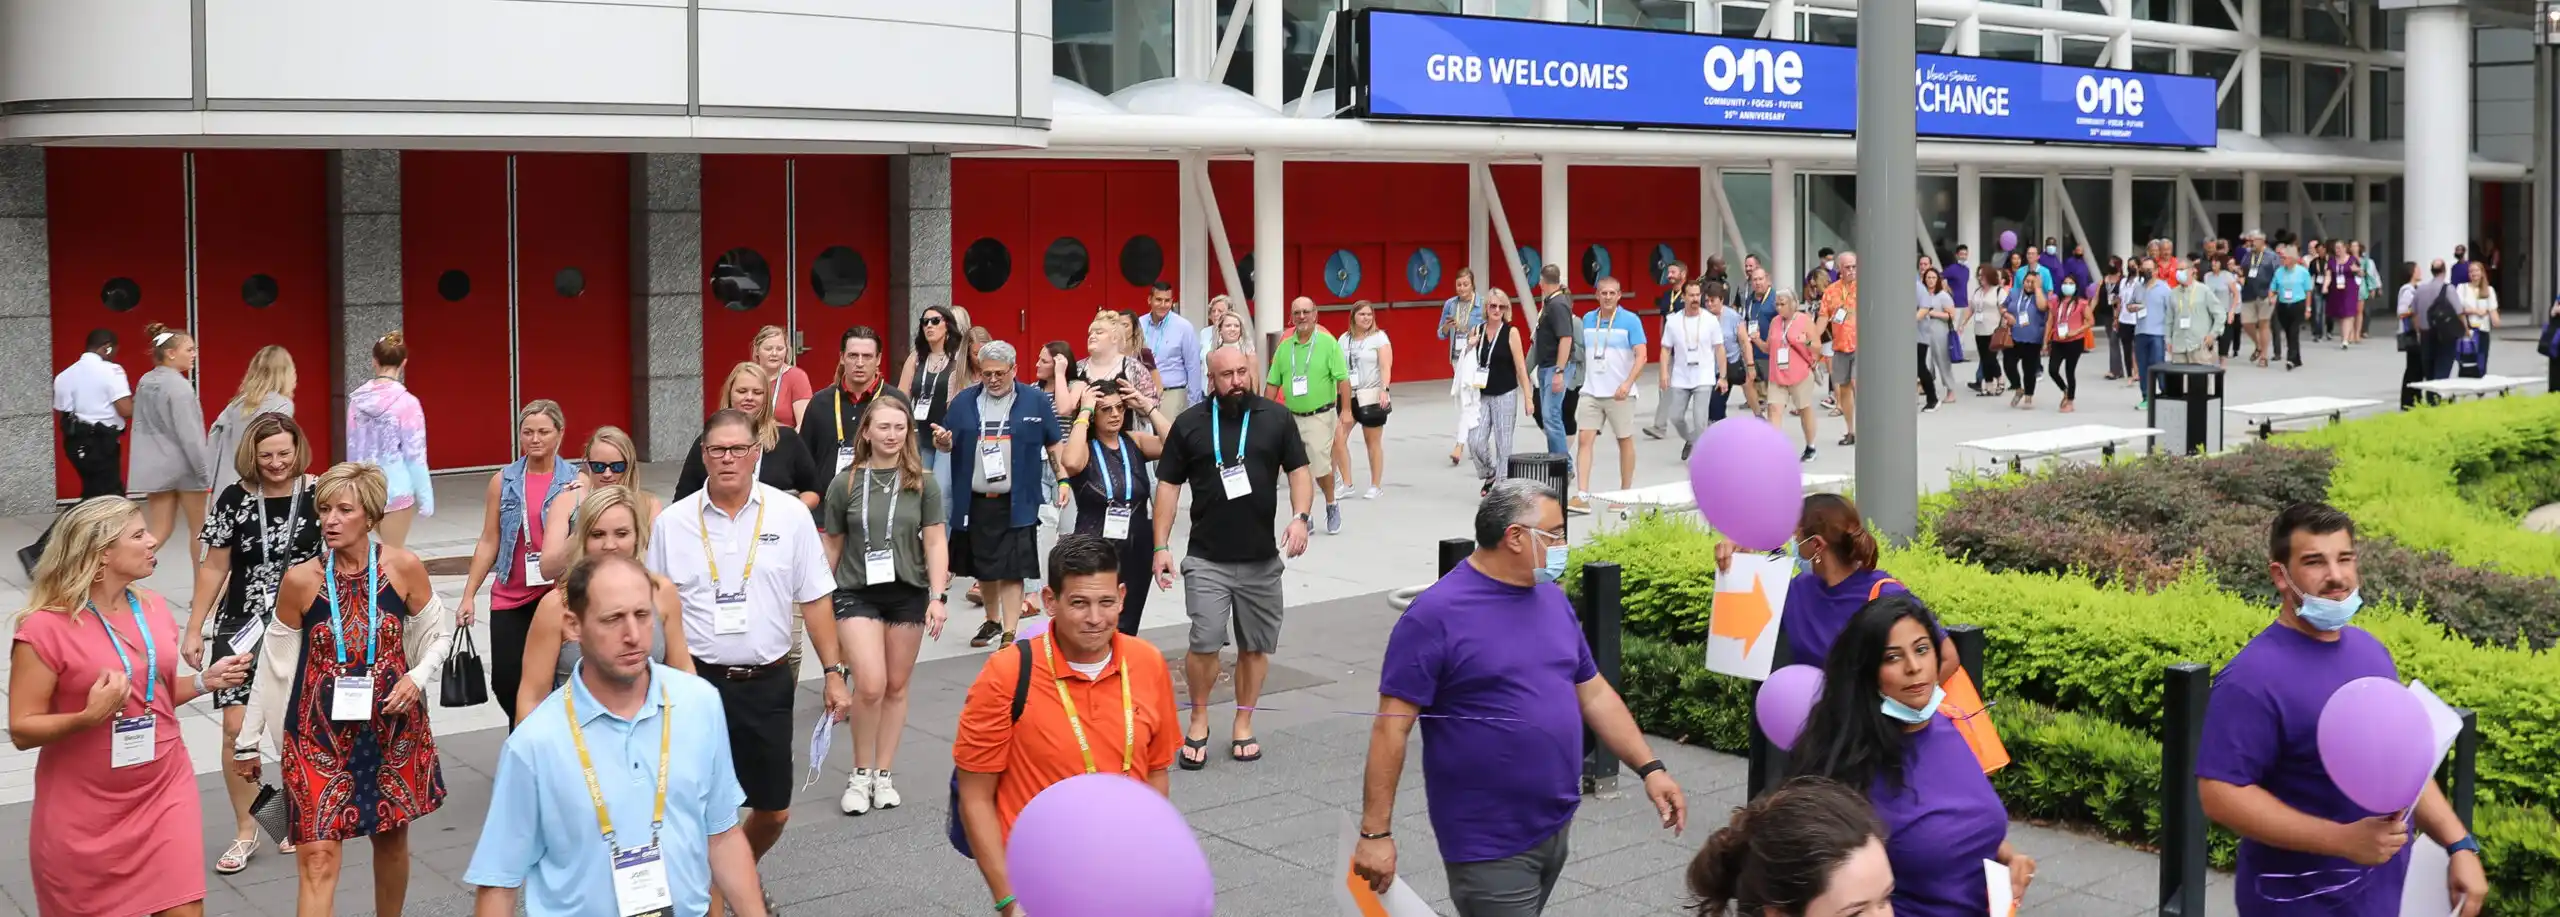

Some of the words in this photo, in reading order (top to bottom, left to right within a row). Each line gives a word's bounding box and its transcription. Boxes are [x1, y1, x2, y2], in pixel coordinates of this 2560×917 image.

[1427, 54, 1482, 83] GRB
[1488, 57, 1629, 91] WELCOMES
[1703, 96, 1747, 107] COMMUNITY
[1751, 98, 1774, 108] FOCUS
[1778, 100, 1803, 110] FUTURE
[1916, 81, 2010, 116] CHANGE
[1739, 111, 1786, 121] ANNIVERSARY
